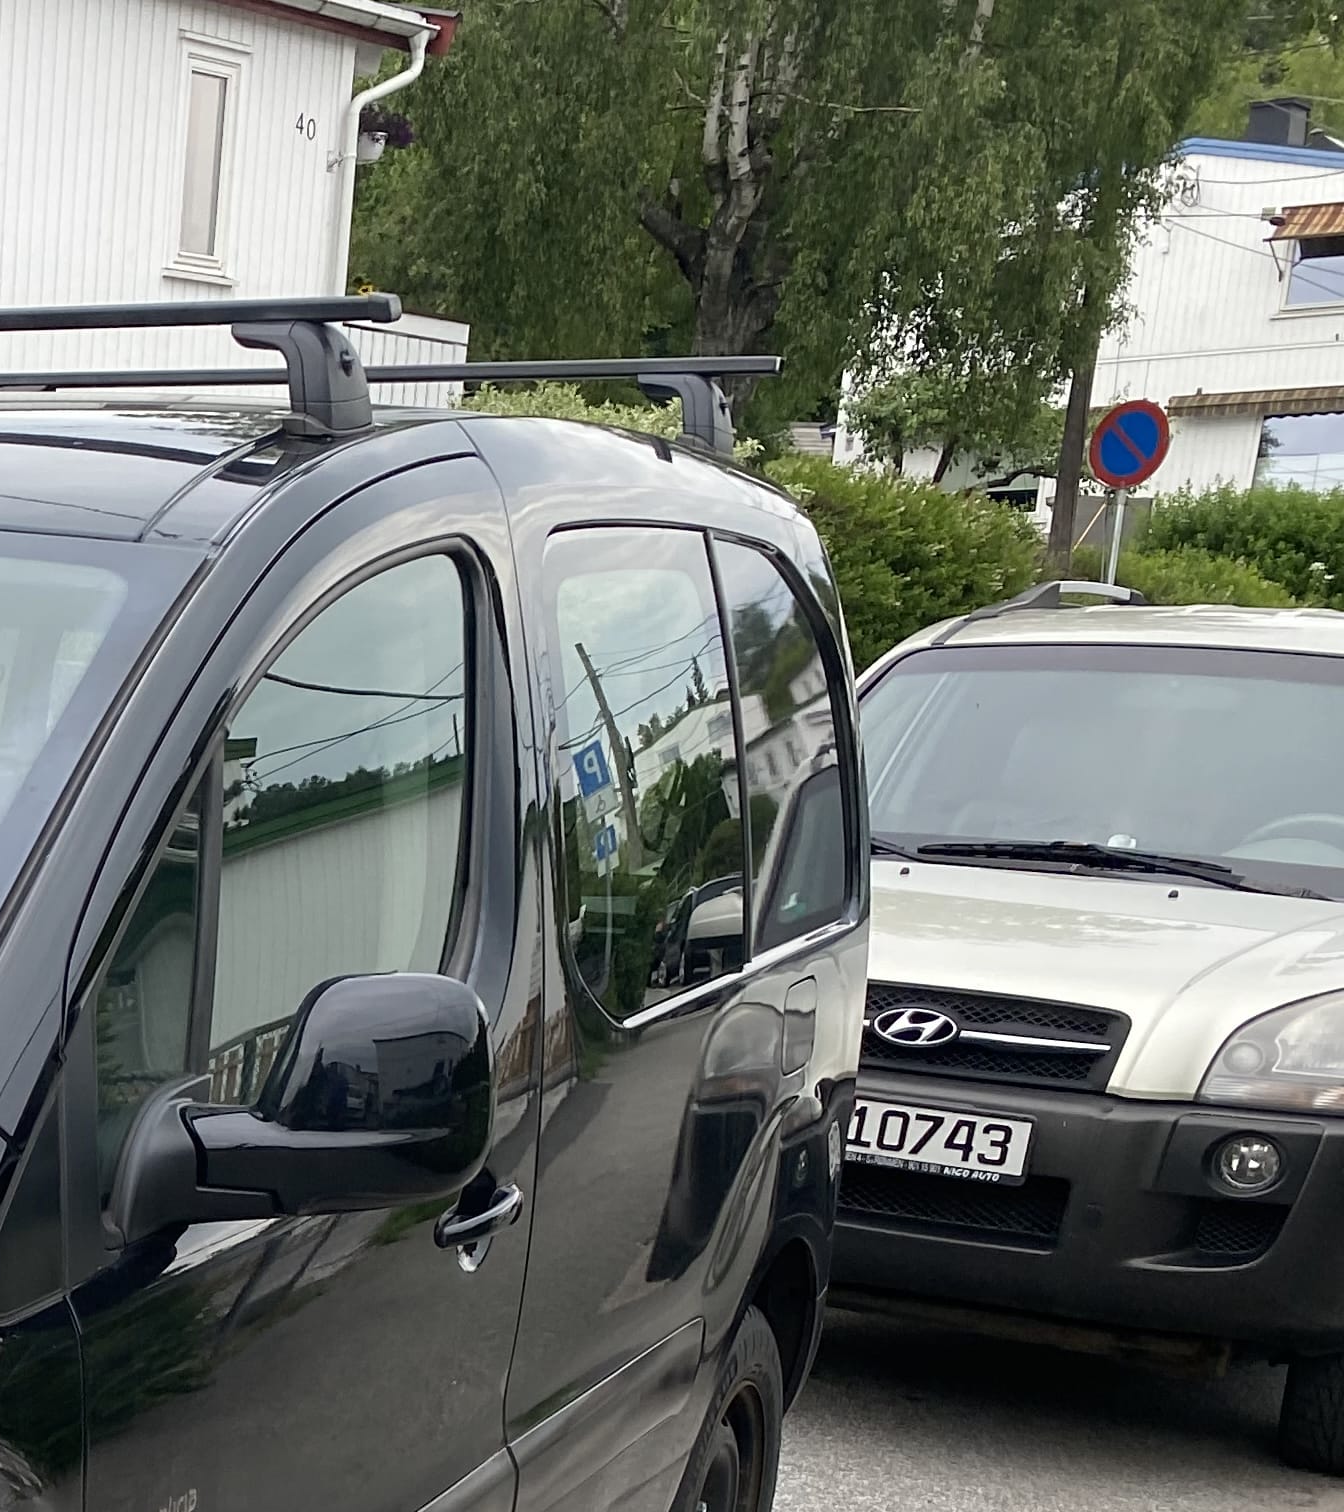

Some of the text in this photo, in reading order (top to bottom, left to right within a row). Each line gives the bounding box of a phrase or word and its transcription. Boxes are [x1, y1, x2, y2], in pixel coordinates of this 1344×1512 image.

[295, 112, 316, 140] 40
[846, 1106, 1013, 1167] 10743
[971, 1170, 1000, 1182] AUTO
